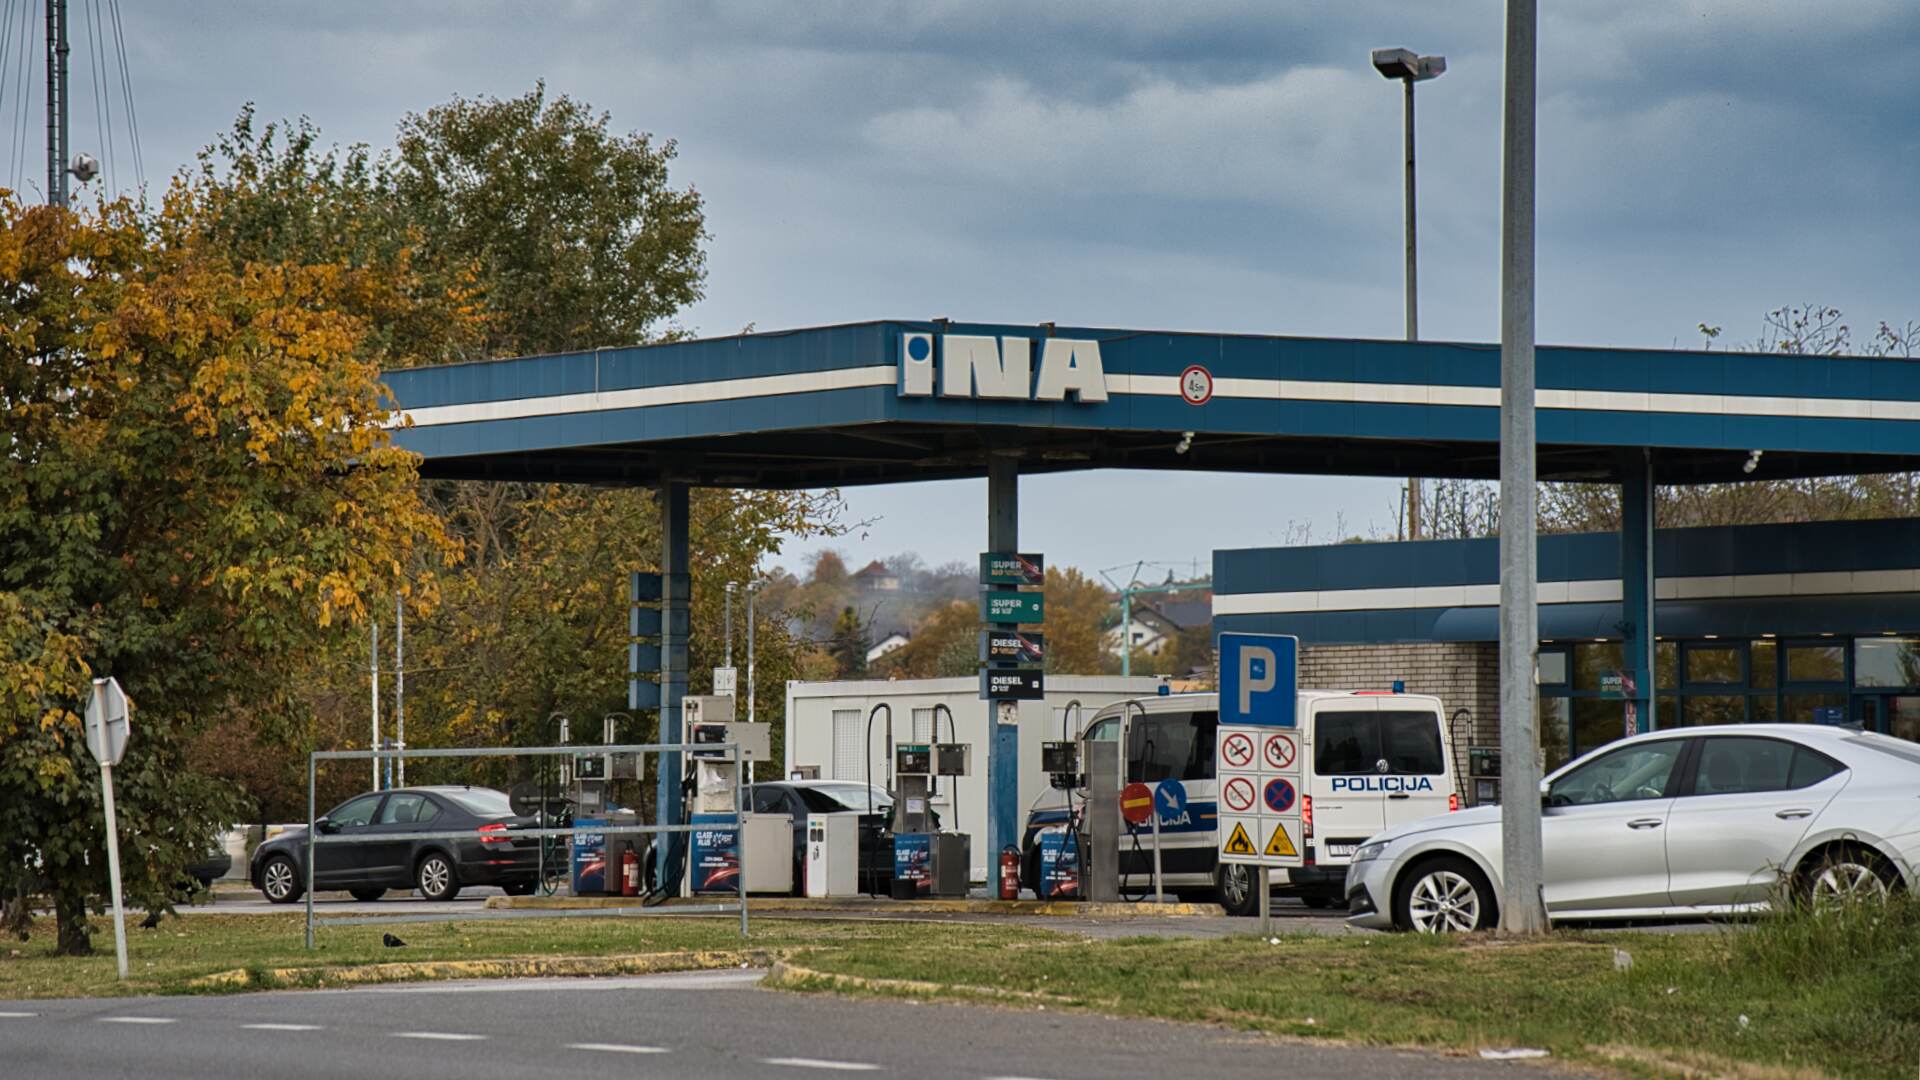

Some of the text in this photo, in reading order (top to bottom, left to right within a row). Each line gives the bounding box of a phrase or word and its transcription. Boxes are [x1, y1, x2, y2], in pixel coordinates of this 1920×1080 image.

[993, 599, 1022, 608] SUPER
[993, 639, 1023, 648] DIESEL
[993, 676, 1023, 685] DIESEL
[1239, 645, 1276, 715] P
[1332, 777, 1433, 791] POLICIJA
